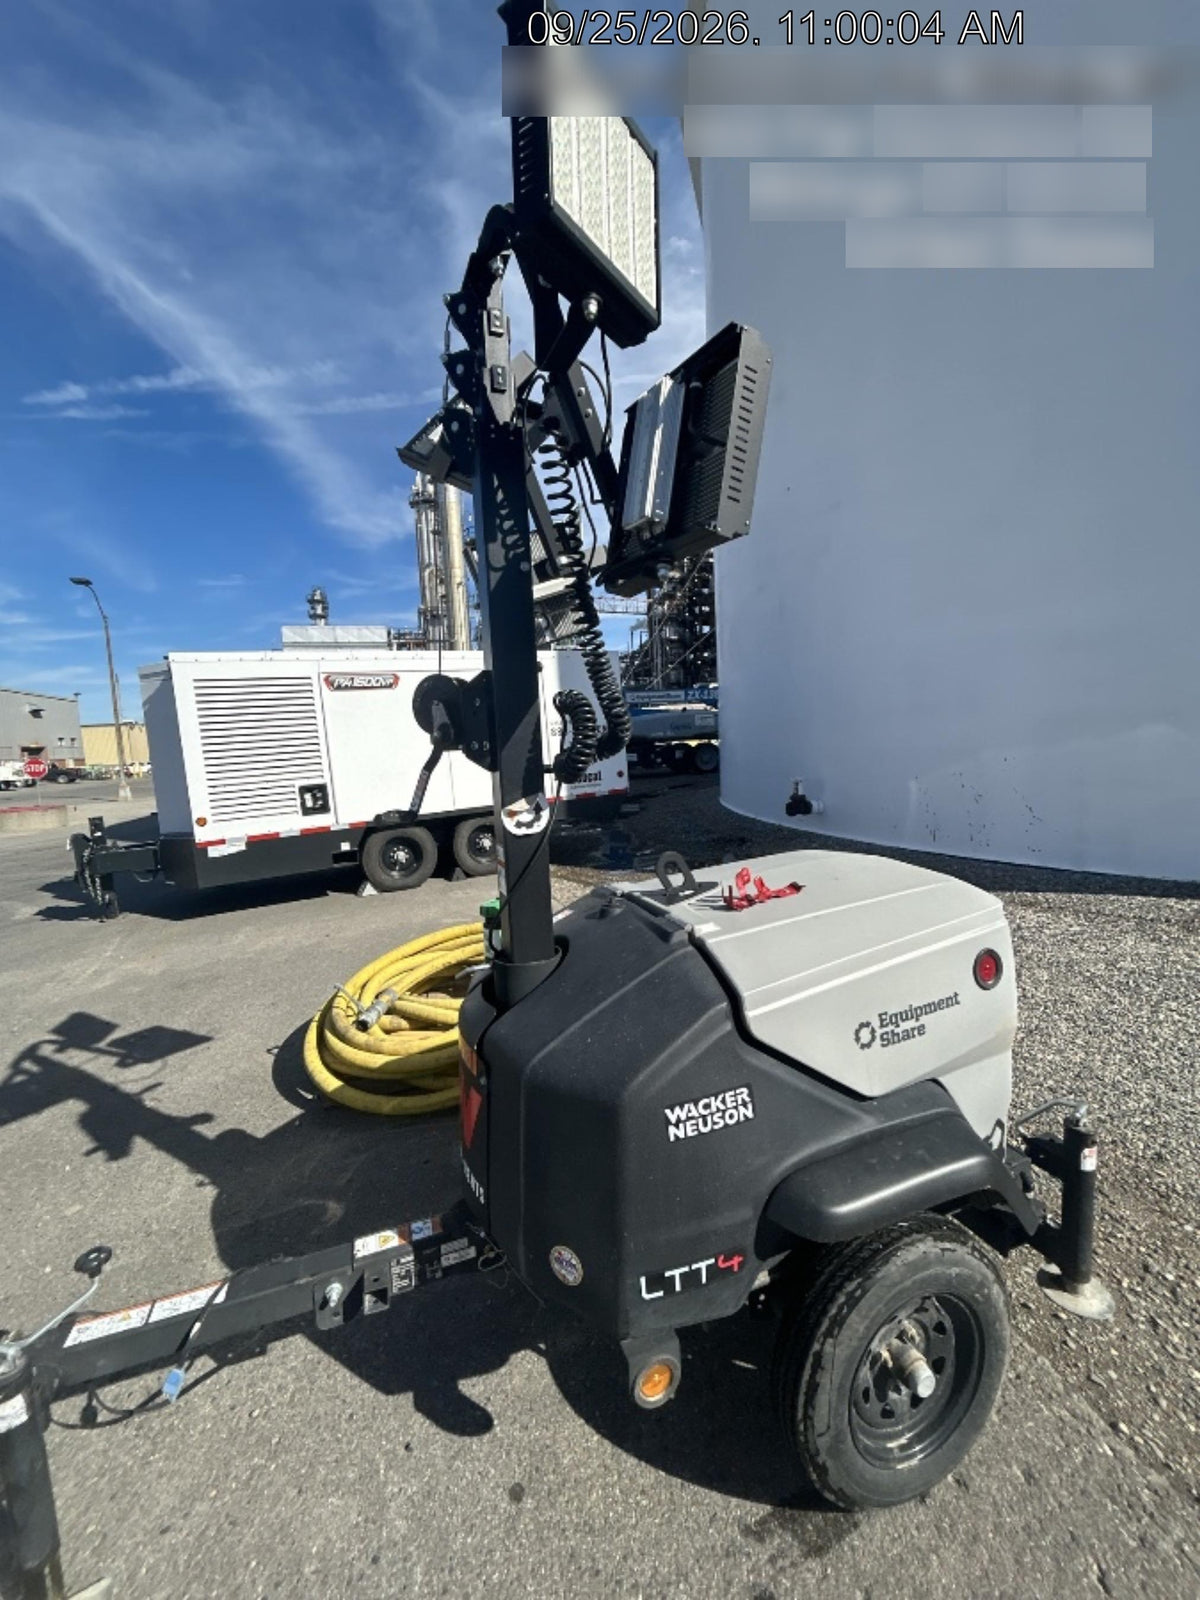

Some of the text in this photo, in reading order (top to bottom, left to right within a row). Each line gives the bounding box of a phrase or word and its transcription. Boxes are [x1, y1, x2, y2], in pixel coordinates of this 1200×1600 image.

[25, 764, 45, 772] STOP
[878, 991, 961, 1029] Equipment
[879, 1023, 926, 1048] Share
[664, 1087, 752, 1124] WACKER
[668, 1102, 754, 1142] NEUSON
[640, 1254, 743, 1300] LTT4
